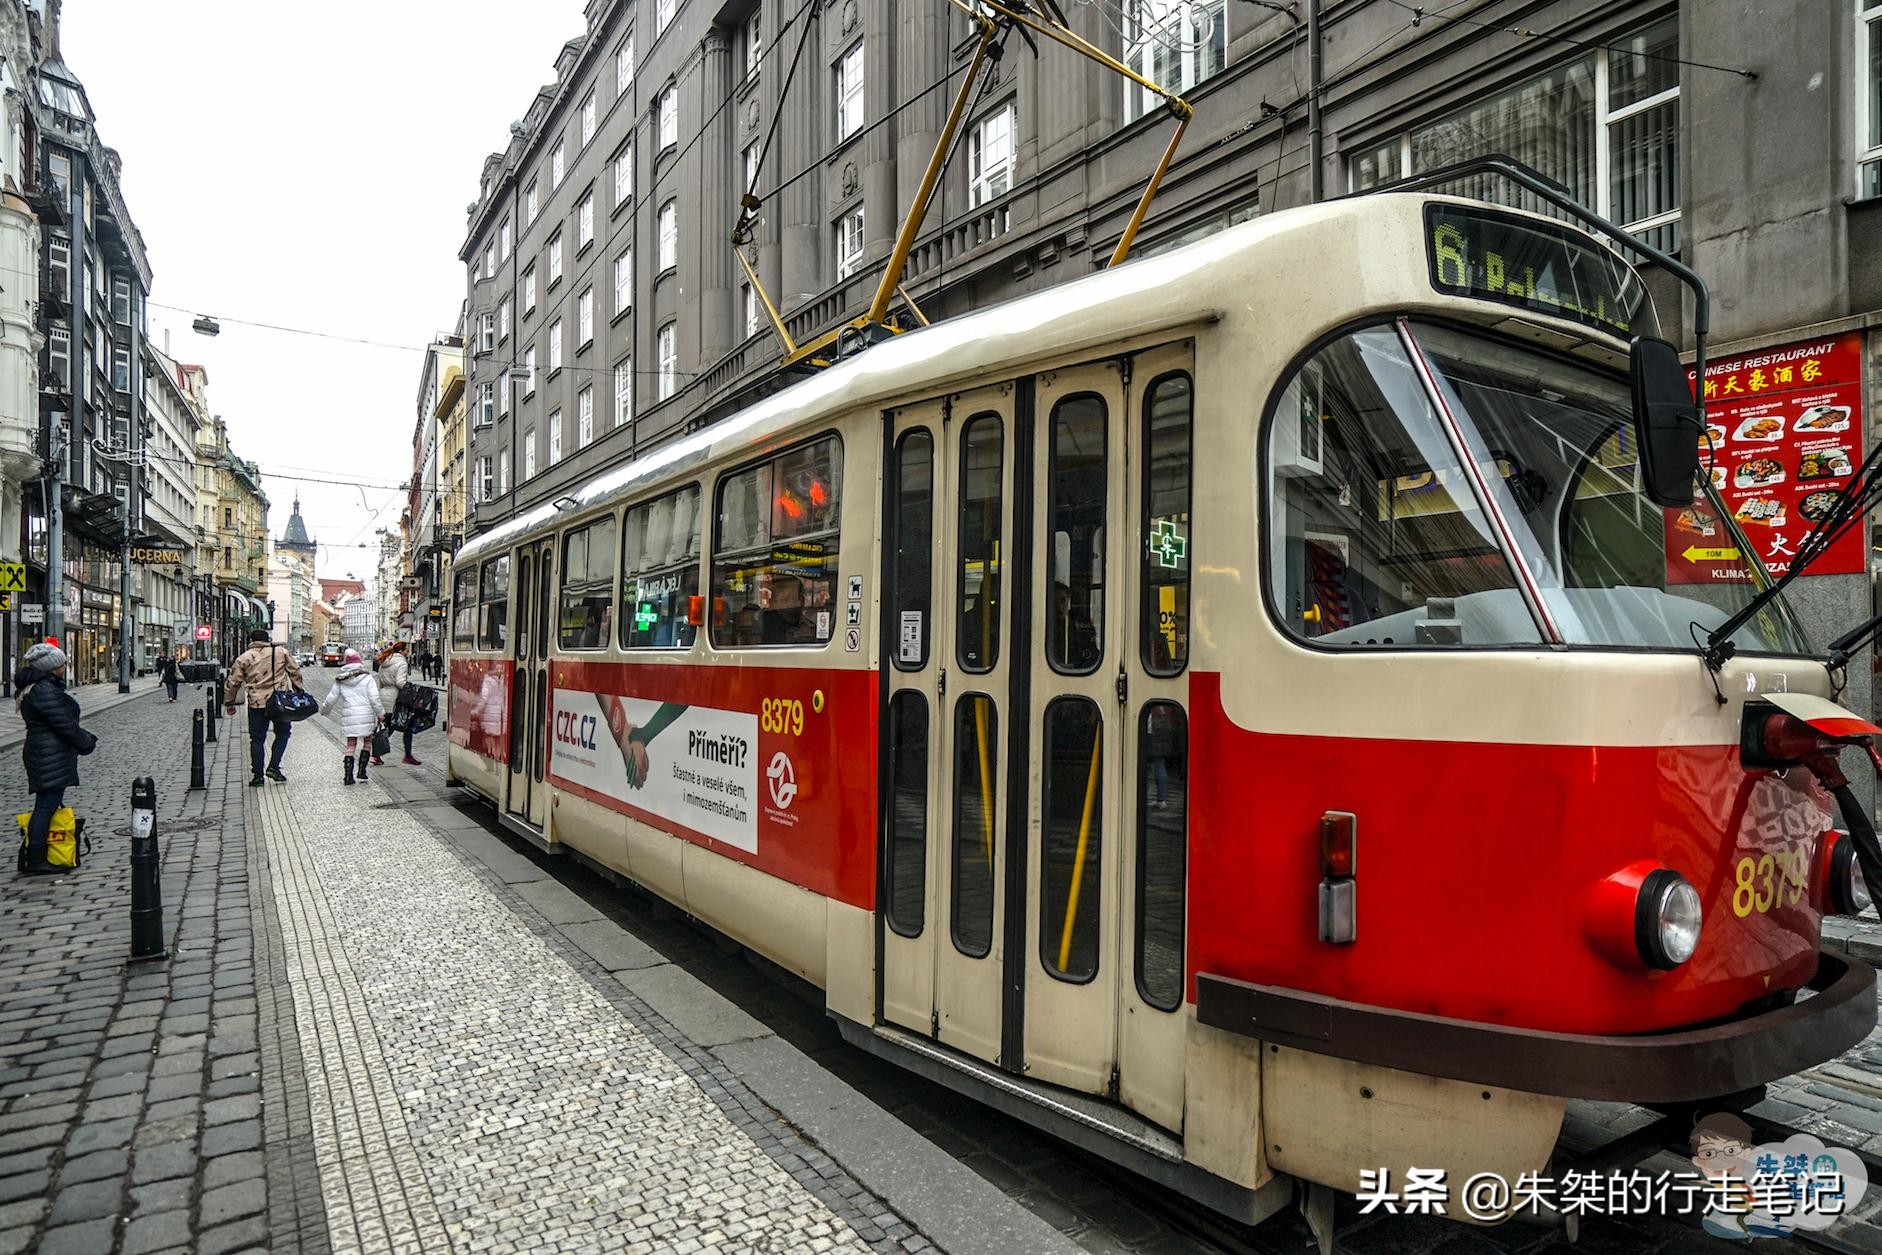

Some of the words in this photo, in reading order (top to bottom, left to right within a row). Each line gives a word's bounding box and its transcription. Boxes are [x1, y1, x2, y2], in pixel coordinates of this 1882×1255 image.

[1688, 361, 1742, 380] CINESE
[1743, 342, 1836, 370] RESTAURANT
[129, 547, 181, 563] UCERNA
[1706, 550, 1722, 558] 10M
[556, 709, 597, 751] CZC.CZ
[761, 697, 804, 736] 8379
[688, 729, 747, 769] Příměří?
[672, 761, 696, 784] Šťastné
[696, 774, 701, 785] a
[702, 776, 724, 793] veselé
[725, 779, 748, 802] všem,
[687, 791, 747, 824] mimozemšťanům
[1732, 847, 1808, 919] 8379
